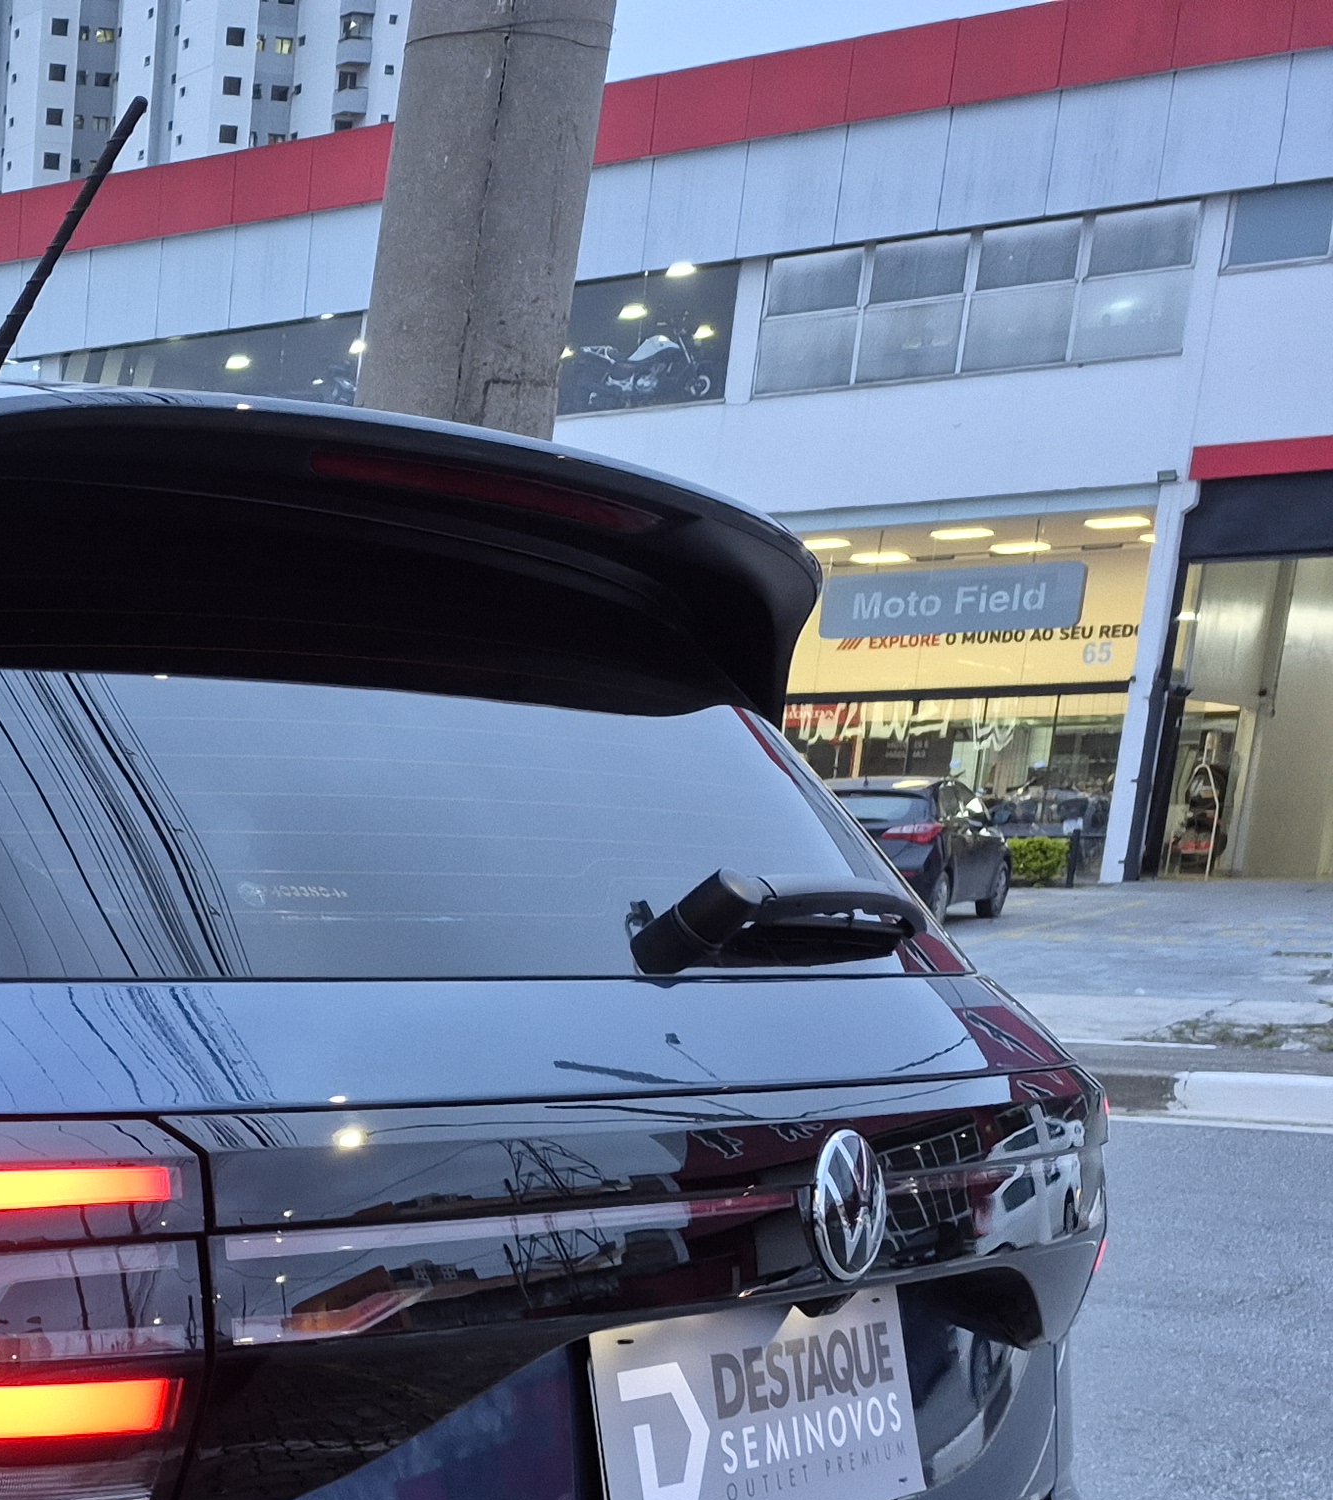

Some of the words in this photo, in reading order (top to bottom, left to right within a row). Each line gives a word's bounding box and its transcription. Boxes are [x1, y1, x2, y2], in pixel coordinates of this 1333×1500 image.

[852, 591, 942, 620] Moto
[954, 582, 1048, 616] Field
[868, 633, 941, 650] EXPLORE
[945, 633, 956, 646] O
[961, 630, 1025, 645] MUNDO
[1029, 628, 1055, 642] AO
[1059, 625, 1094, 640] SEU
[1082, 641, 1113, 665] 65
[710, 1321, 895, 1420] DESTAQUE
[720, 1391, 903, 1475] SEMINOVOS
[825, 1439, 908, 1478] PREMIUM
